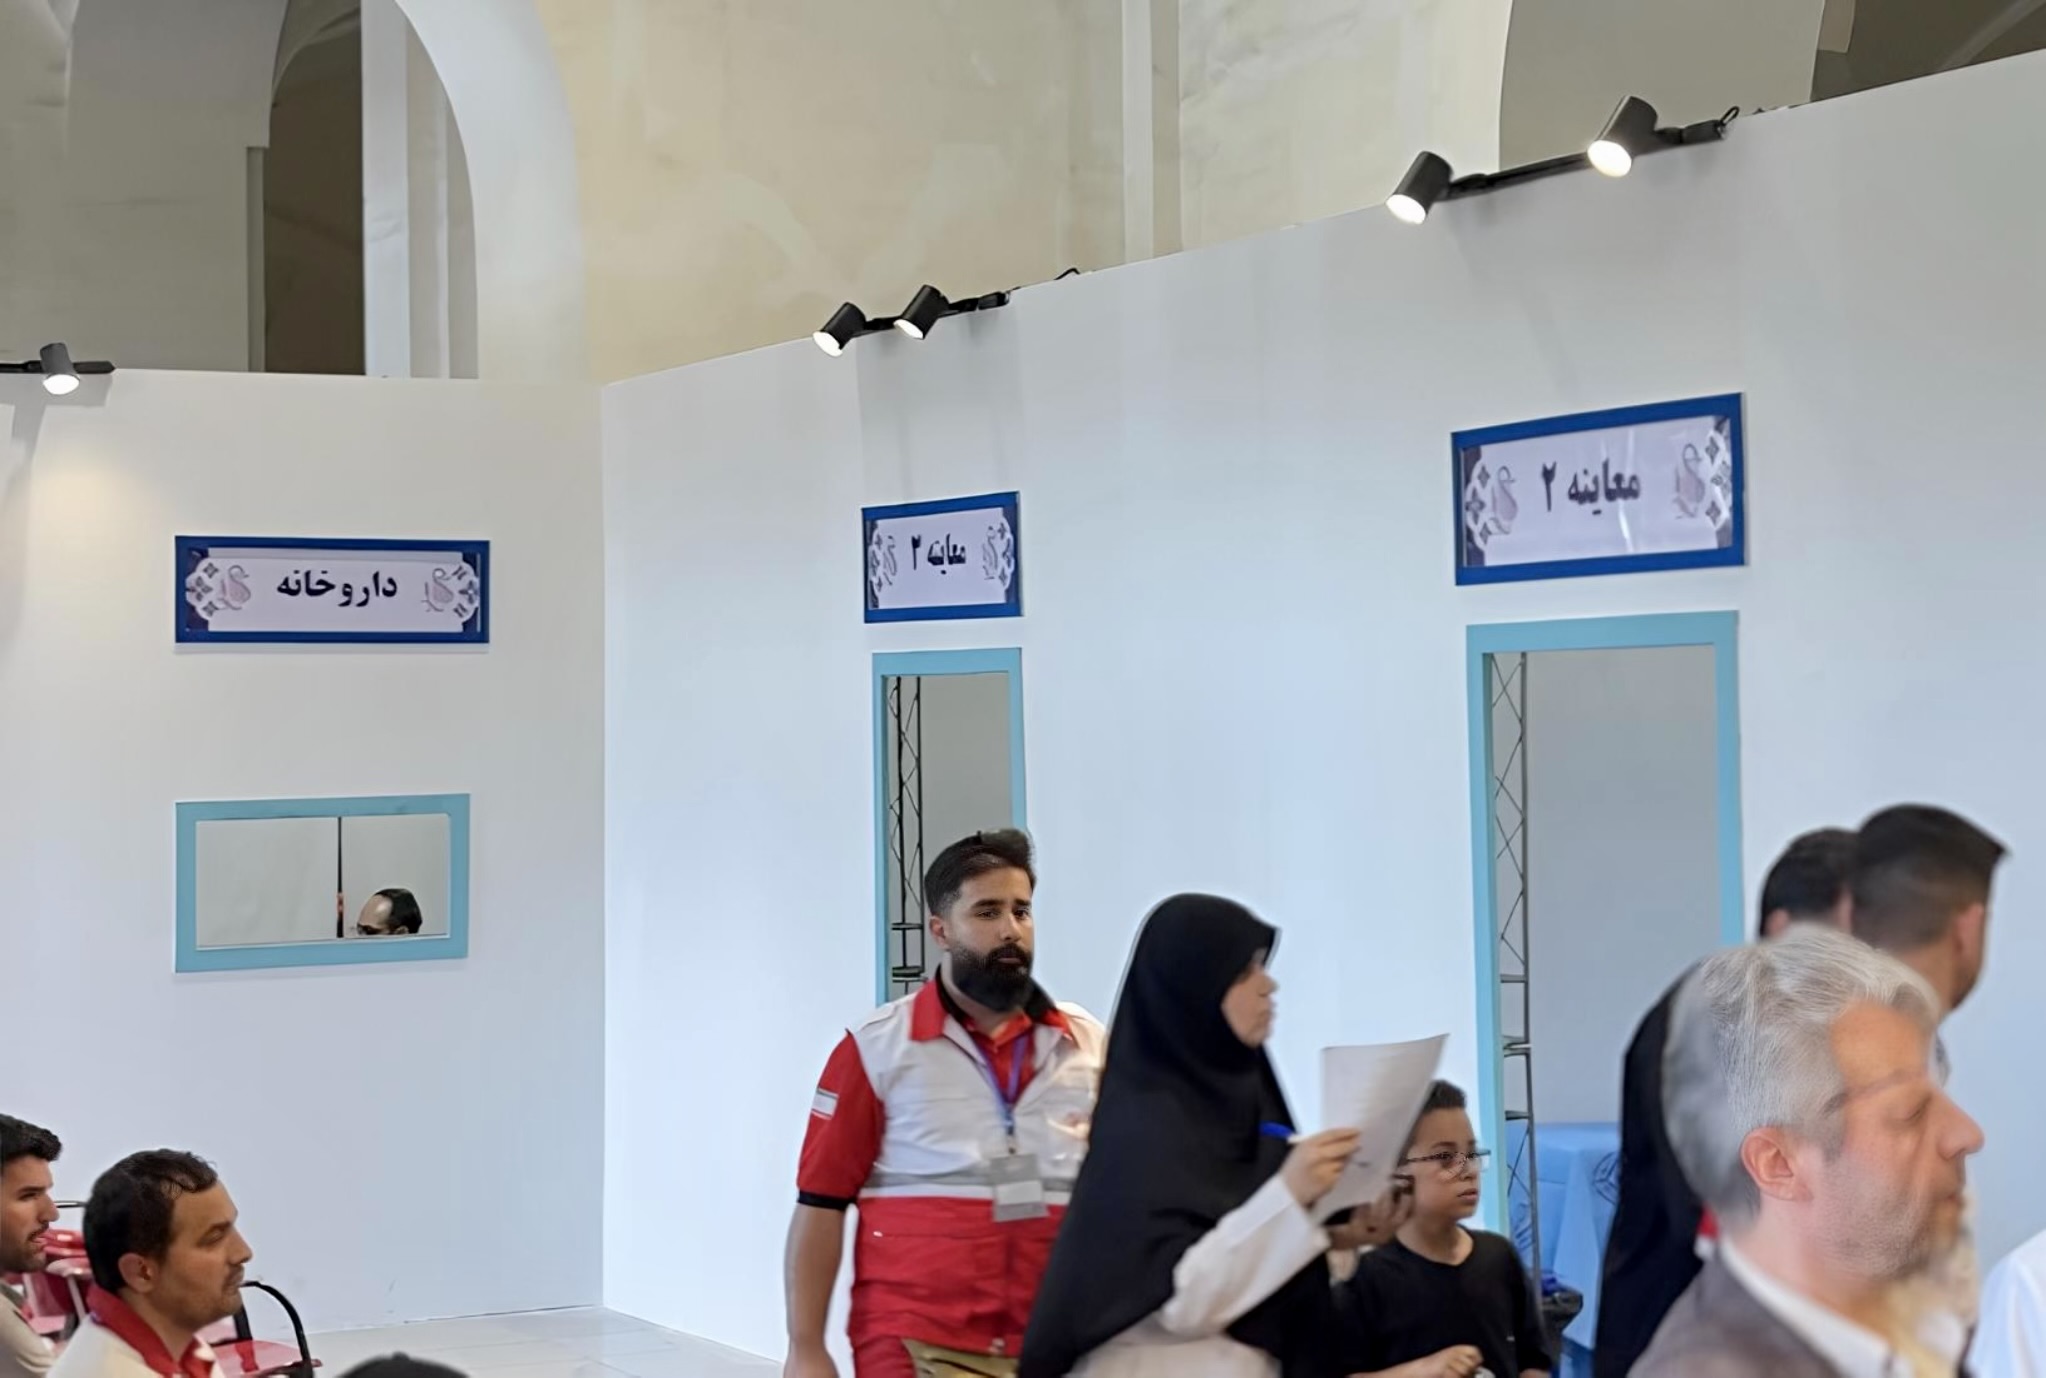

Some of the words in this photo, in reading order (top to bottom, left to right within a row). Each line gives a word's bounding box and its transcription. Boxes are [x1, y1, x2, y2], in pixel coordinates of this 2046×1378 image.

[1541, 461, 1557, 513] ۲
[1567, 457, 1642, 515] معاینه
[276, 569, 398, 607] داروخانه
